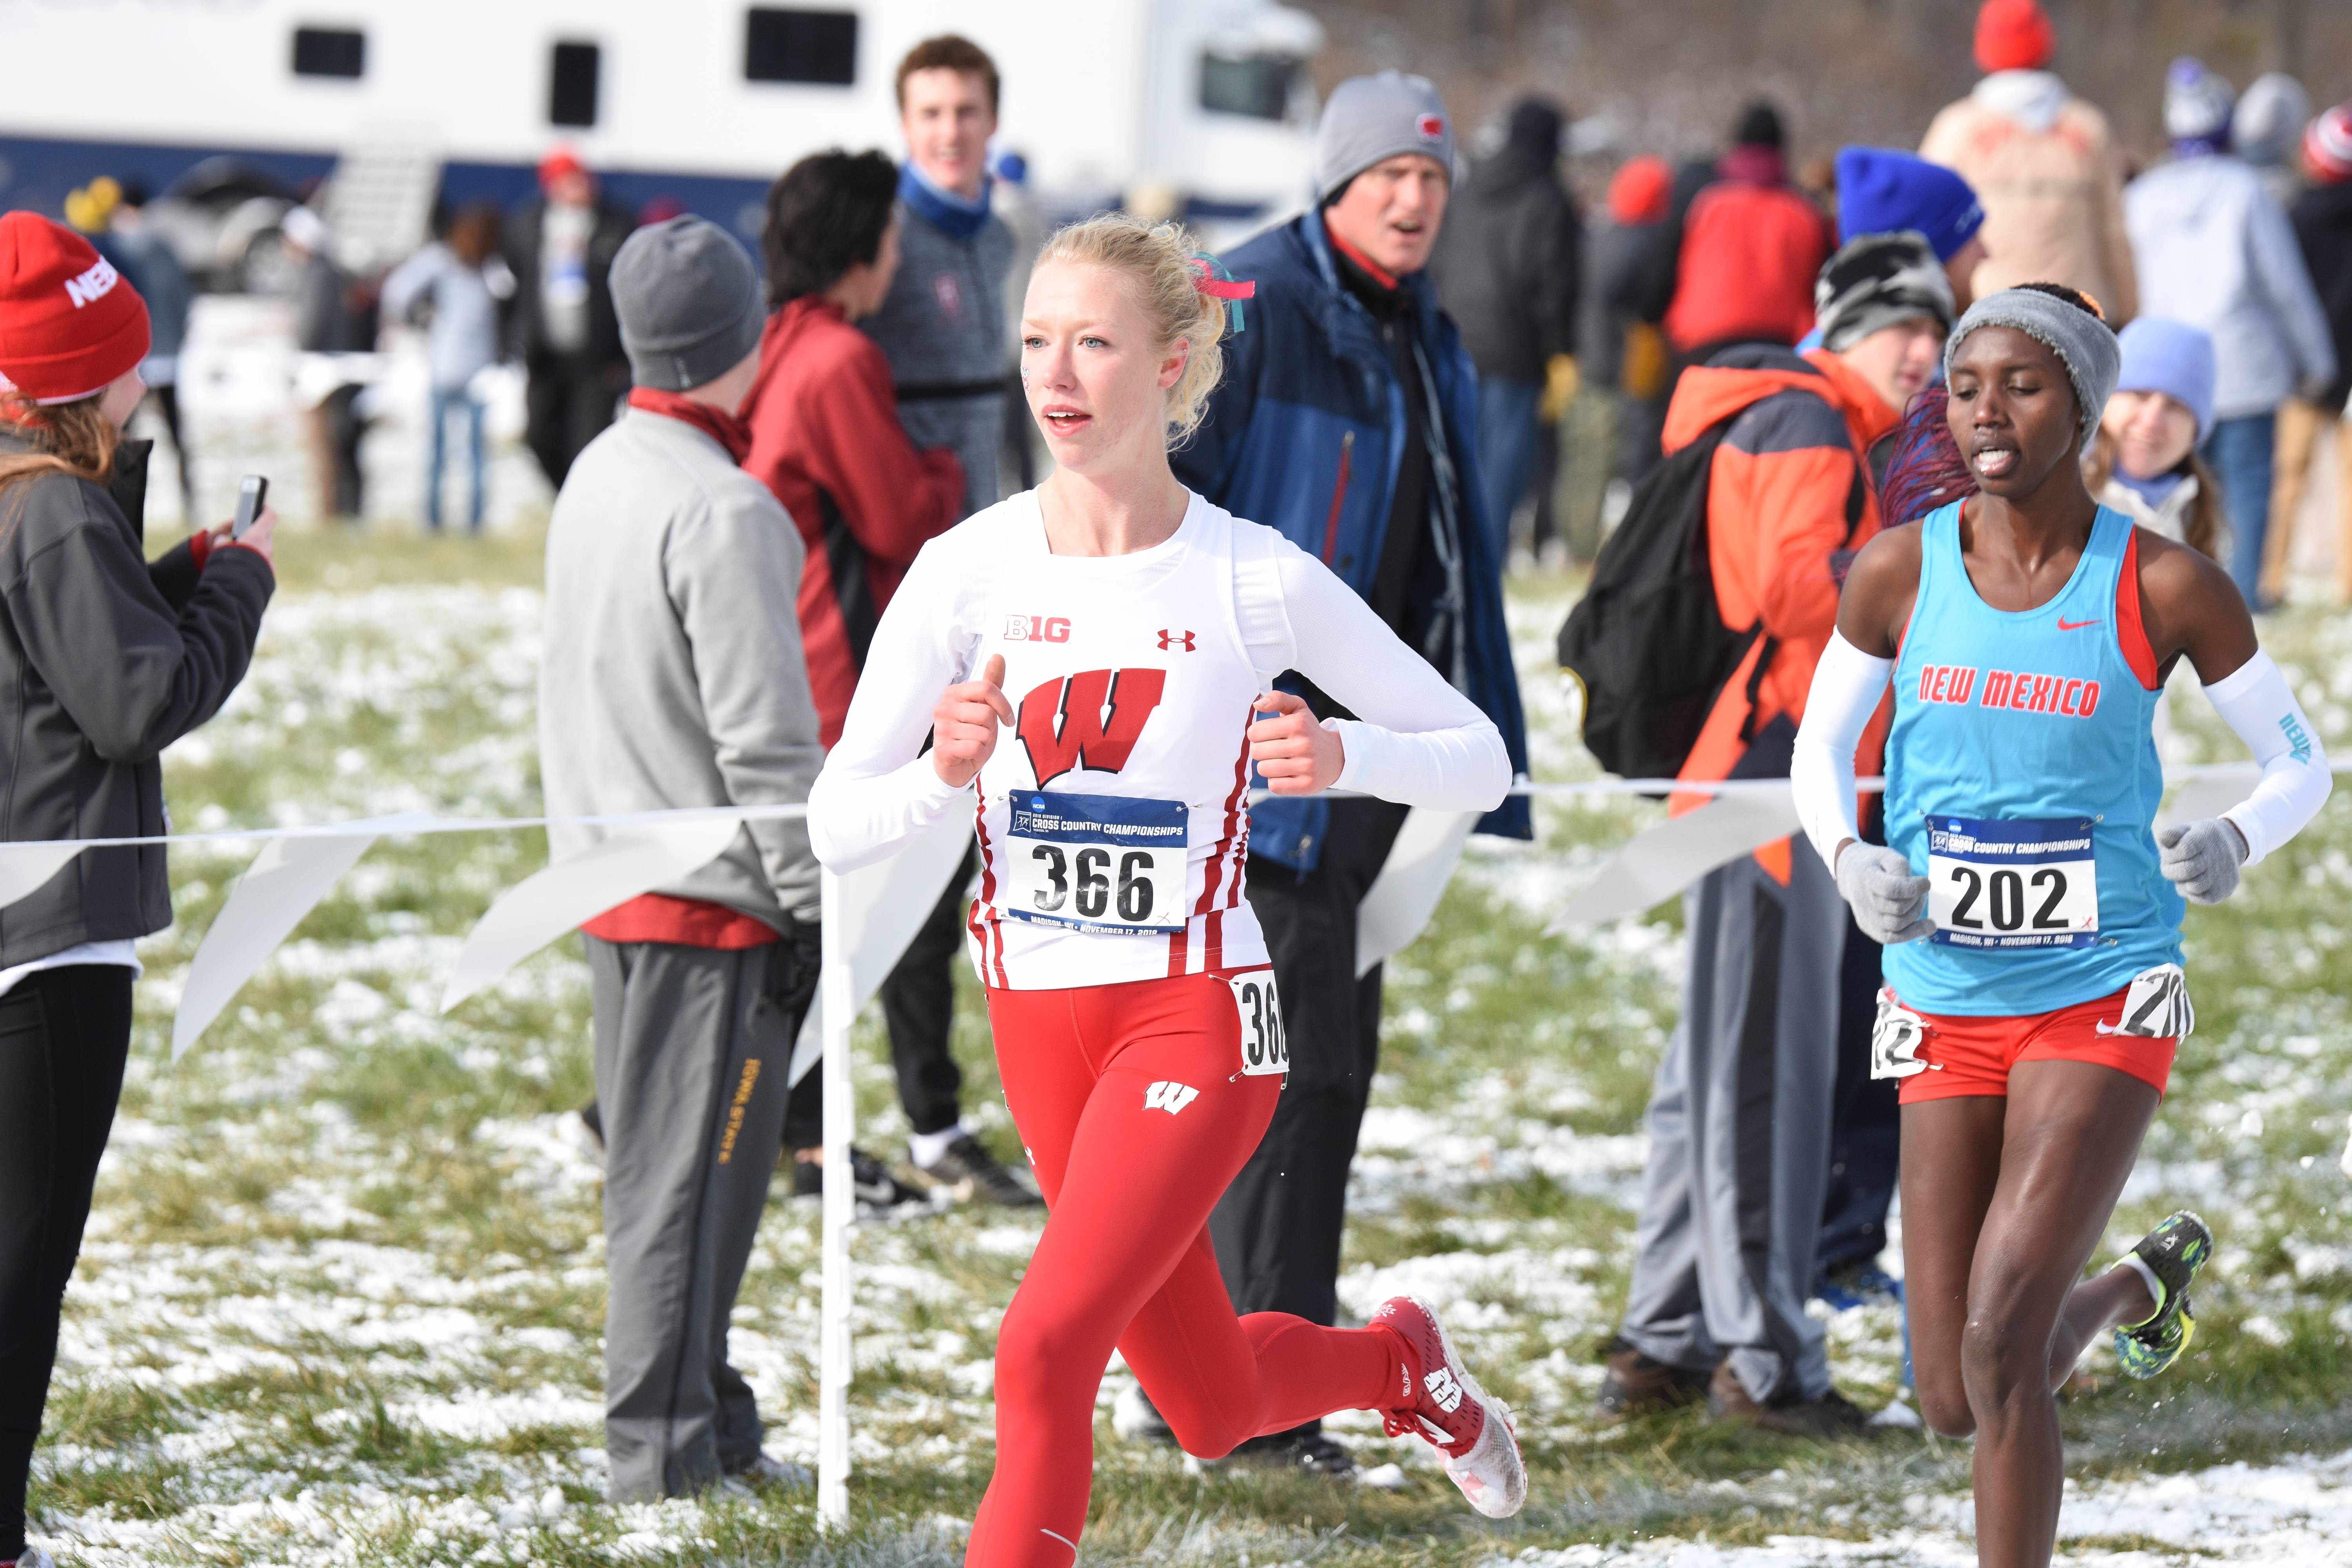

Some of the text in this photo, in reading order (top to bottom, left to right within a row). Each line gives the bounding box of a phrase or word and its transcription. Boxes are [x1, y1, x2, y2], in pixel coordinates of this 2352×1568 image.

[1917, 664, 2101, 719] NEW MEXICO
[1015, 668, 1167, 791] W
[1032, 818, 1059, 830] CROSS
[1061, 820, 1102, 831] COUNTRY
[1103, 823, 1183, 836] CHAMPIONSHIPS
[1973, 842, 2016, 855] COUNTRY
[2016, 838, 2091, 855] CHAMPIONSHIPS
[1032, 844, 1154, 922] 366
[1950, 866, 2070, 931] 202
[1080, 924, 1123, 935] NOVEMBER
[1949, 933, 1982, 946] MADISON,
[1983, 936, 1994, 947] WI
[2000, 936, 2041, 946] NOVEMBER
[2042, 935, 2053, 945] 17,
[1142, 1081, 1200, 1115] W
